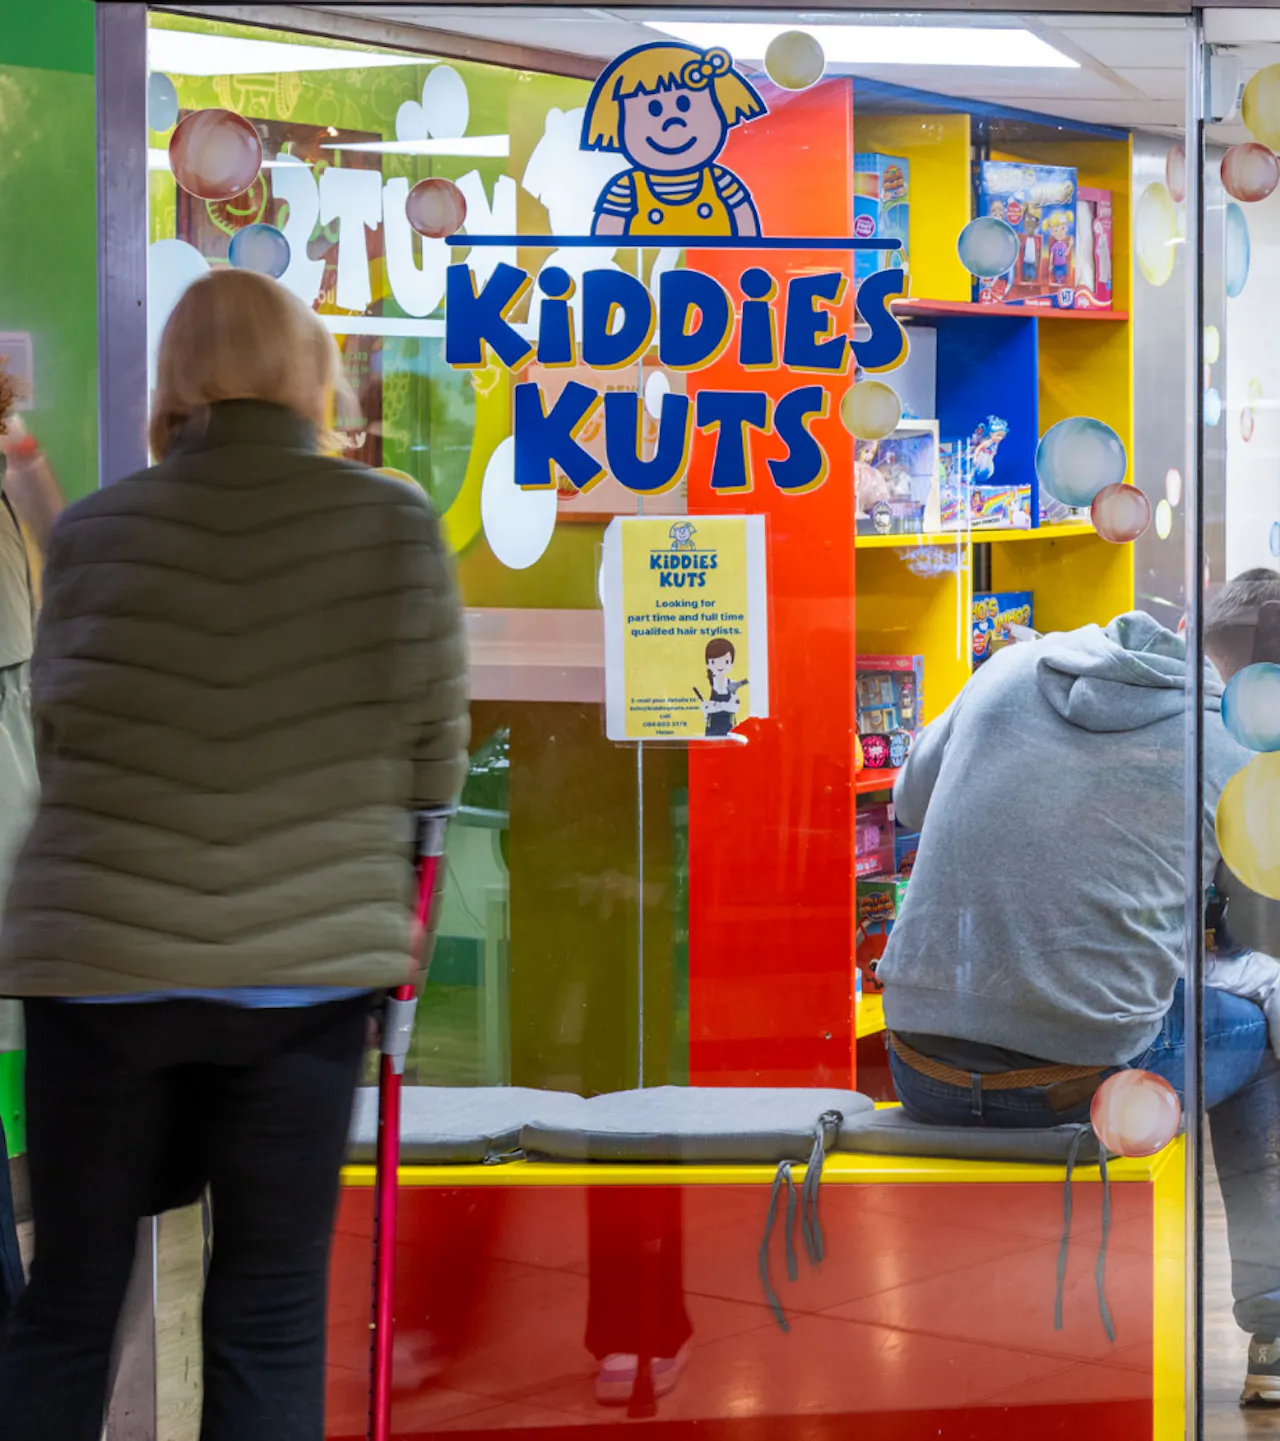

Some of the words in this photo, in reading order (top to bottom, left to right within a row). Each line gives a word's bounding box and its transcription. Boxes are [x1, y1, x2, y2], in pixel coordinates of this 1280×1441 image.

[513, 380, 830, 495] KUTS
[659, 572, 706, 587] KUTS
[656, 600, 698, 609] Looking
[700, 600, 716, 608] for
[972, 597, 998, 622] HO'S
[627, 614, 650, 624] part
[652, 614, 676, 622] time
[679, 613, 698, 622] and
[701, 613, 718, 621] full
[720, 612, 744, 621] time
[677, 626, 697, 635] hair
[700, 626, 742, 636] stylists.
